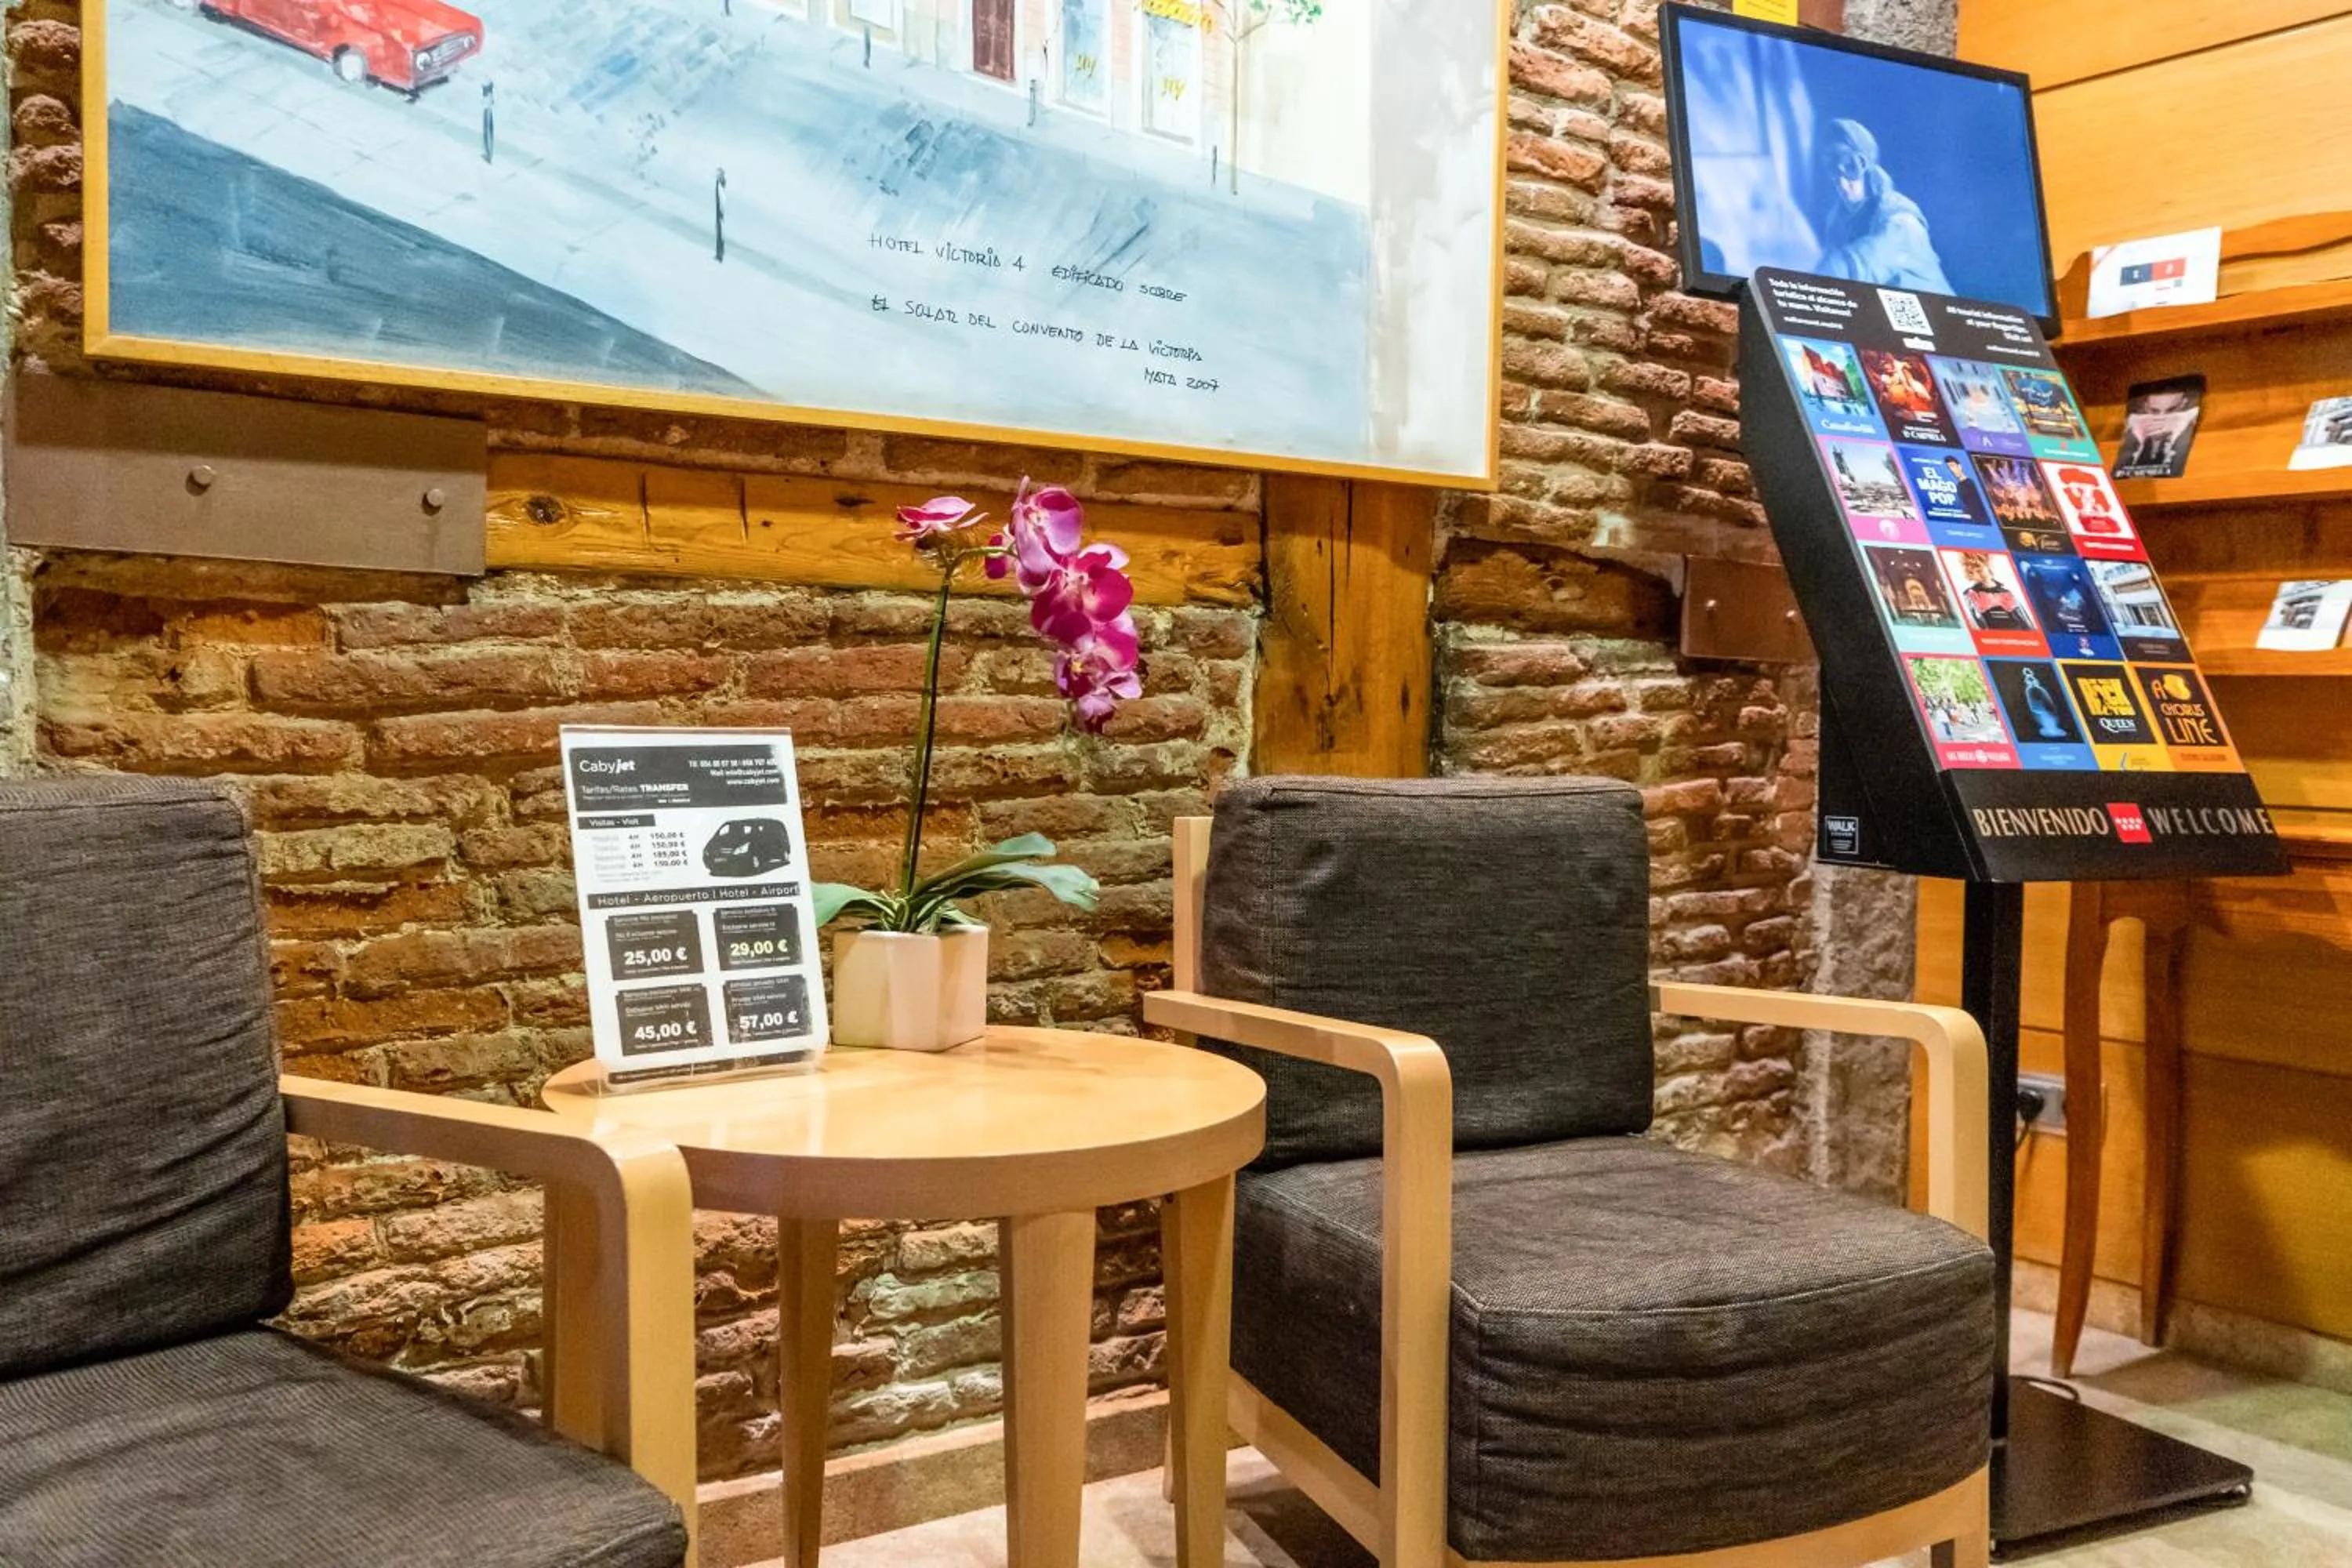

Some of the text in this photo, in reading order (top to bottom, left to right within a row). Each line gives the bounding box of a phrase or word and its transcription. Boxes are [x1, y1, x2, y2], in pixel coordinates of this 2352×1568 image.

[867, 233, 924, 254] HOTEL
[1139, 285, 1188, 302] SOBRE
[872, 294, 889, 311] EL
[905, 300, 958, 324] SOLAR
[969, 313, 996, 328] DEL
[1012, 320, 1083, 343] CONVENTO
[1097, 333, 1114, 347] DE
[1120, 339, 1138, 350] LA
[1144, 367, 1220, 392] MATA 2007
[1922, 466, 1942, 479] EL
[1928, 491, 1956, 506] POP
[2161, 702, 2205, 717] CHORUS
[2165, 717, 2219, 744] LINE
[579, 757, 637, 775] Cabyjet
[640, 783, 690, 793] TRANSFER
[1972, 808, 2274, 837] BIENVENIDO WELCOME
[597, 893, 630, 907] Hotel
[644, 891, 709, 904] Aeropuerto
[720, 887, 749, 898] Hotel
[760, 884, 800, 897] Airport
[624, 946, 688, 966] 25,00 €
[730, 938, 788, 957] 29,00 €
[739, 1010, 799, 1029] 57,00 €
[634, 1020, 697, 1041] 45,00 €
